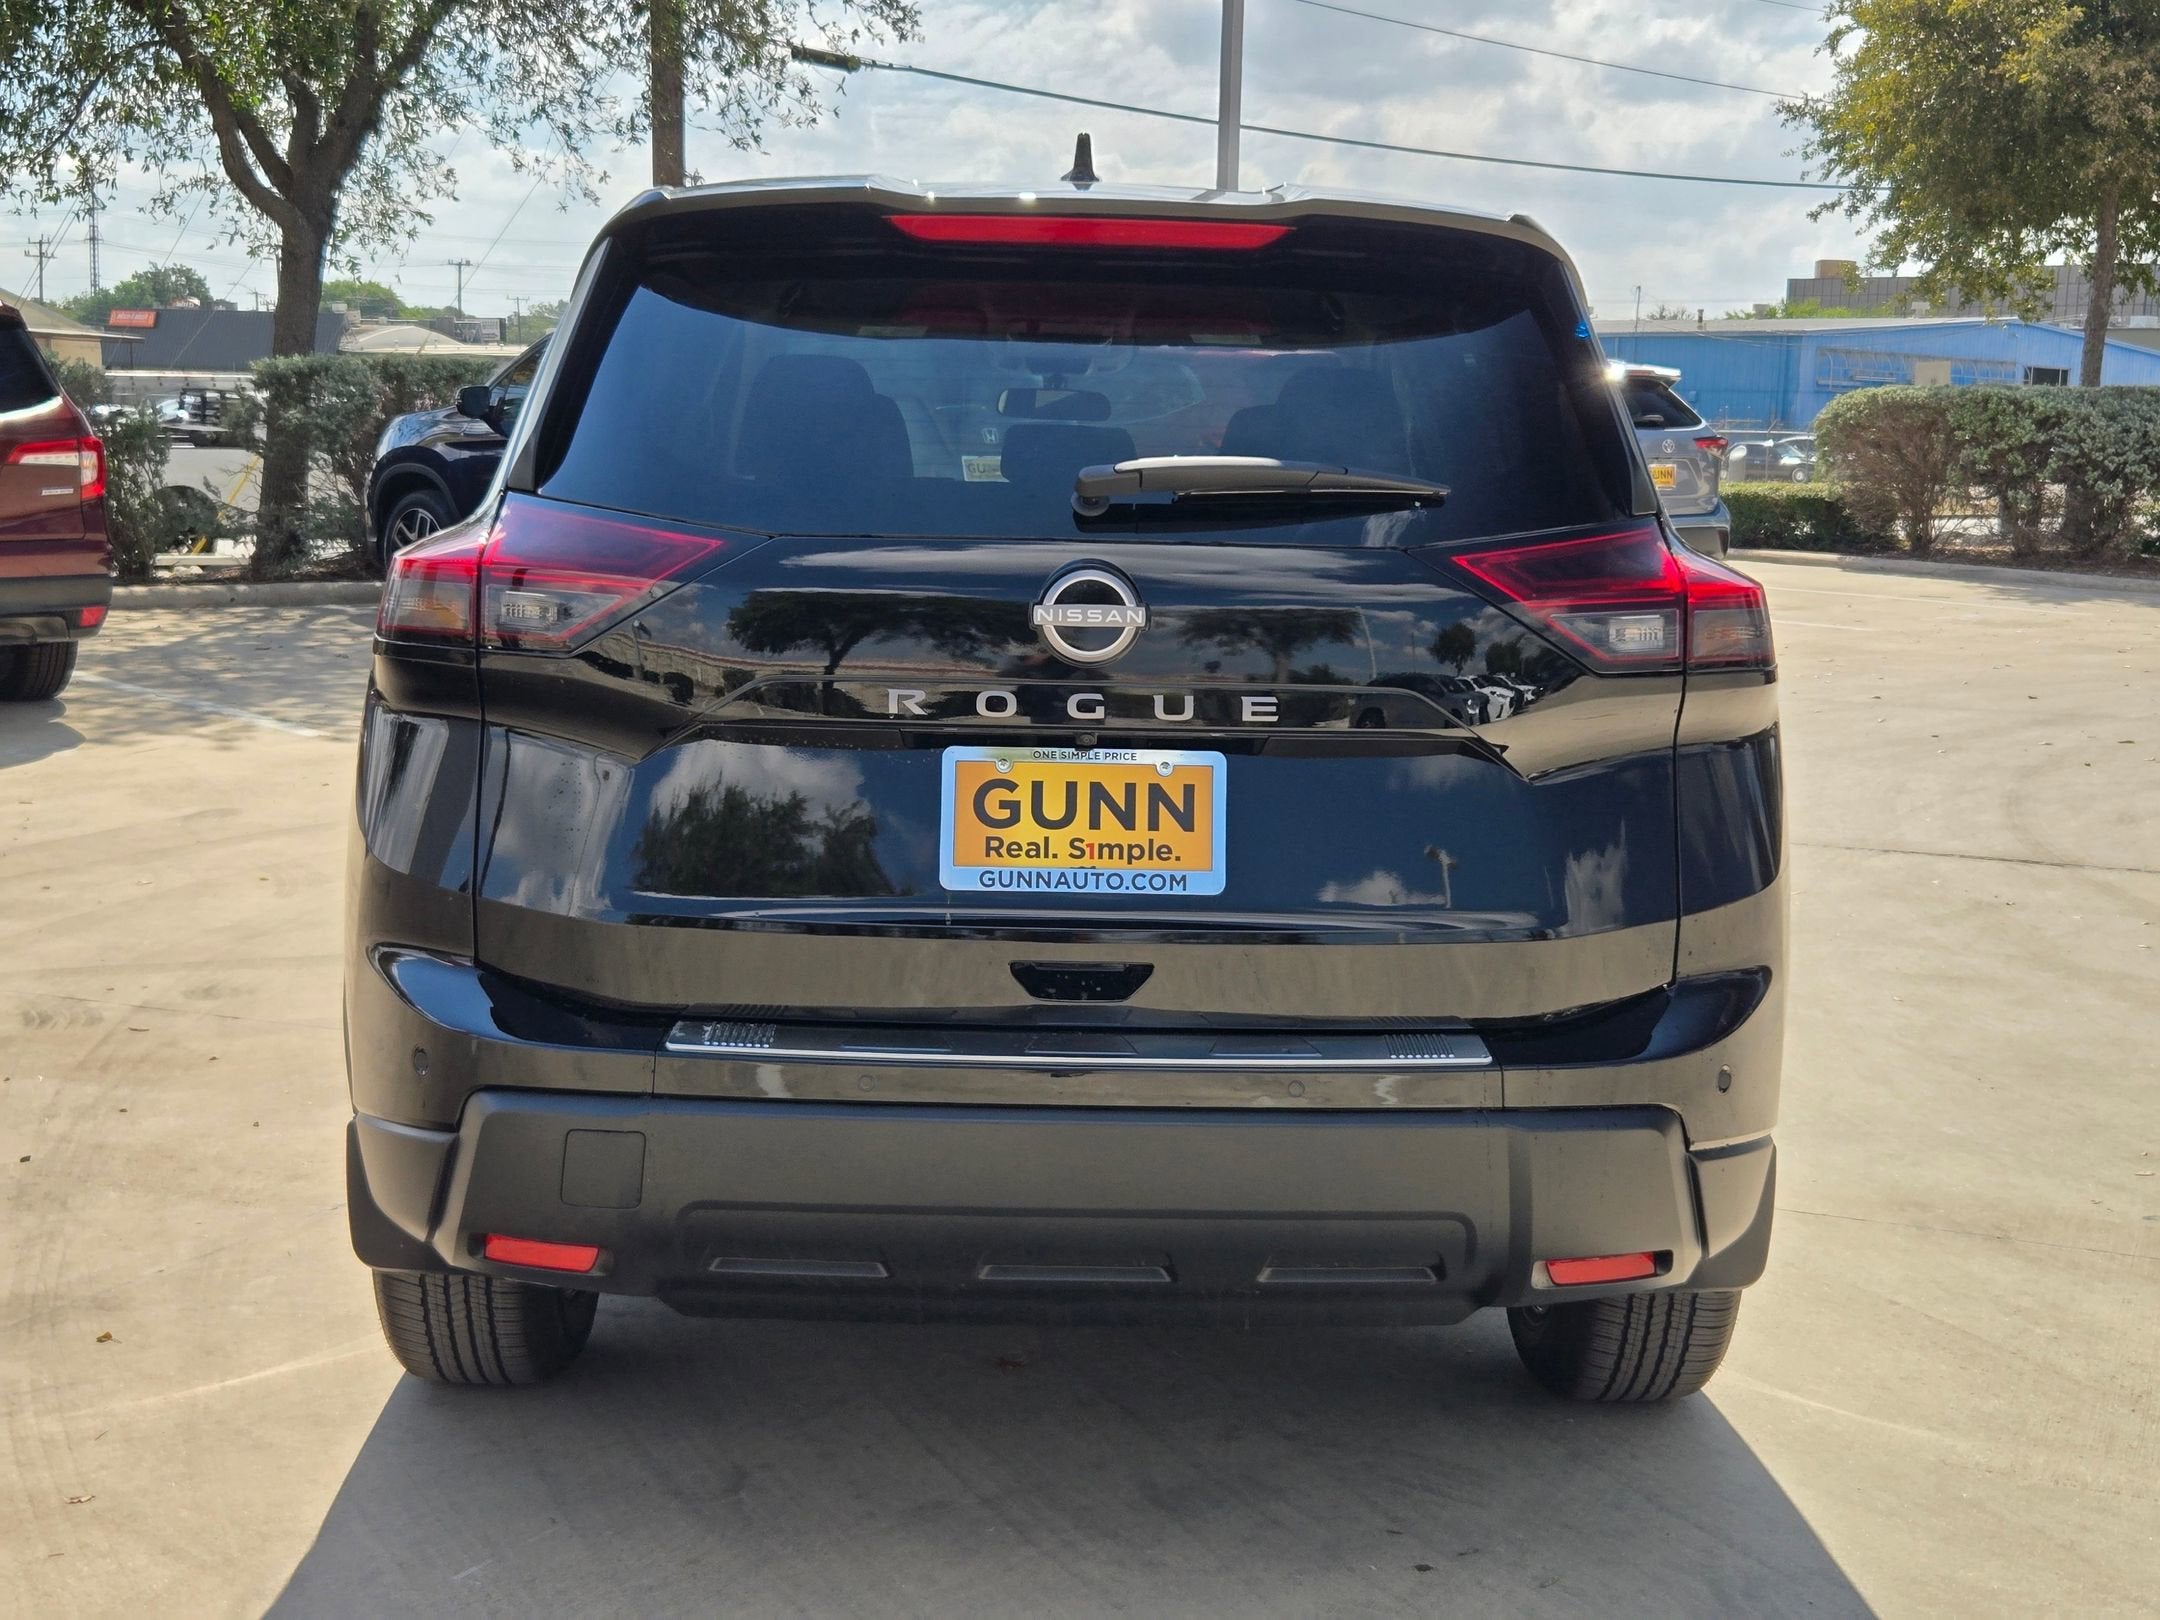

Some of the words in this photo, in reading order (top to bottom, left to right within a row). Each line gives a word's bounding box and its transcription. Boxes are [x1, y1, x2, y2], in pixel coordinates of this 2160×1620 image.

[1037, 608, 1142, 624] NISSAN
[887, 688, 1280, 722] ROGUE
[1033, 750, 1057, 759] ONE
[1060, 750, 1101, 760] SIMPLE
[1104, 752, 1137, 761] PRICE
[973, 778, 1195, 832] GUNN
[985, 836, 1058, 859] Real.
[1068, 837, 1181, 865] S1mple.
[979, 870, 1187, 891] GUNNAUTO.COM
